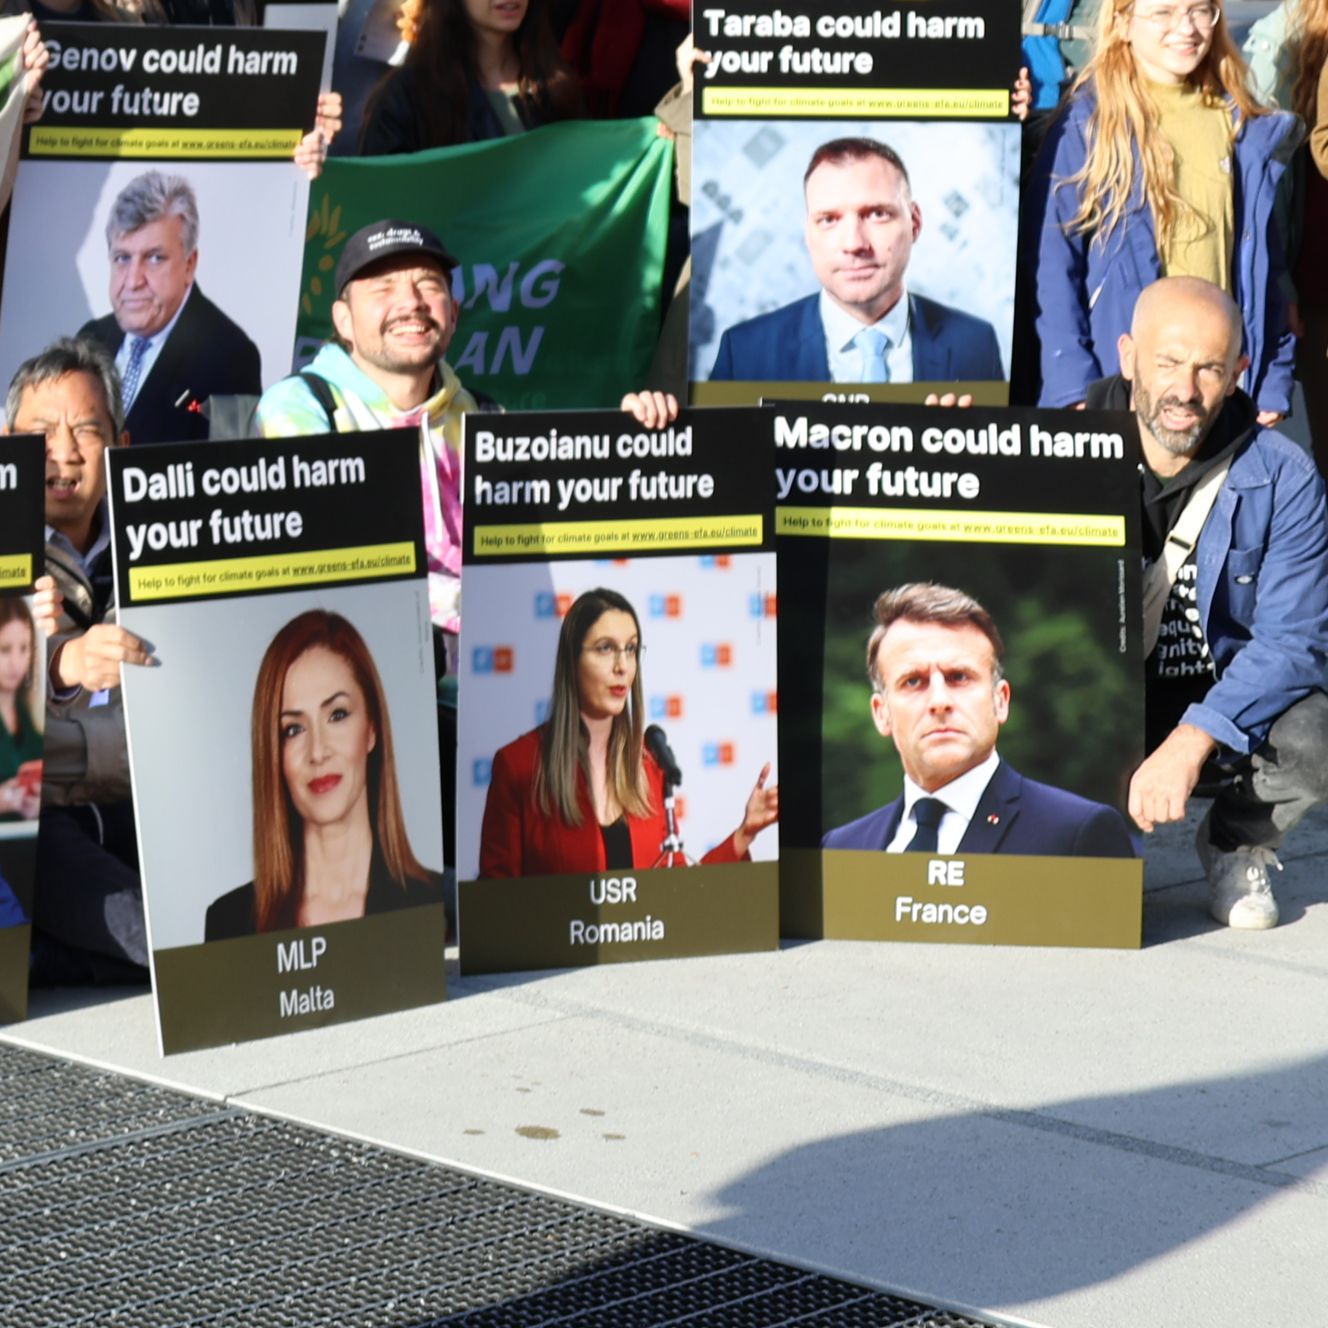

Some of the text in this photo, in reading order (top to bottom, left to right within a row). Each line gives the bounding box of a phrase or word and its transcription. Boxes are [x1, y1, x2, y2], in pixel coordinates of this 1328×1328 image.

[703, 8, 985, 39] Taraba could harm
[37, 38, 298, 75] Genov could harm
[475, 426, 693, 463] Buzoianu could
[774, 415, 1124, 459] Macron could harm
[122, 454, 366, 503] Dalli could harm
[474, 468, 715, 511] harm your future
[776, 461, 980, 499] your future
[480, 535, 504, 548] Help
[504, 535, 516, 546] to
[516, 535, 540, 548] fight
[541, 534, 556, 545] for
[557, 533, 592, 543] climate
[593, 531, 619, 545] goals
[620, 531, 630, 541] at
[928, 859, 965, 886] RE
[590, 876, 637, 905] USR
[895, 896, 988, 925] France
[570, 914, 665, 944] Romania
[277, 936, 327, 974] MLP
[279, 985, 335, 1018] Malta
